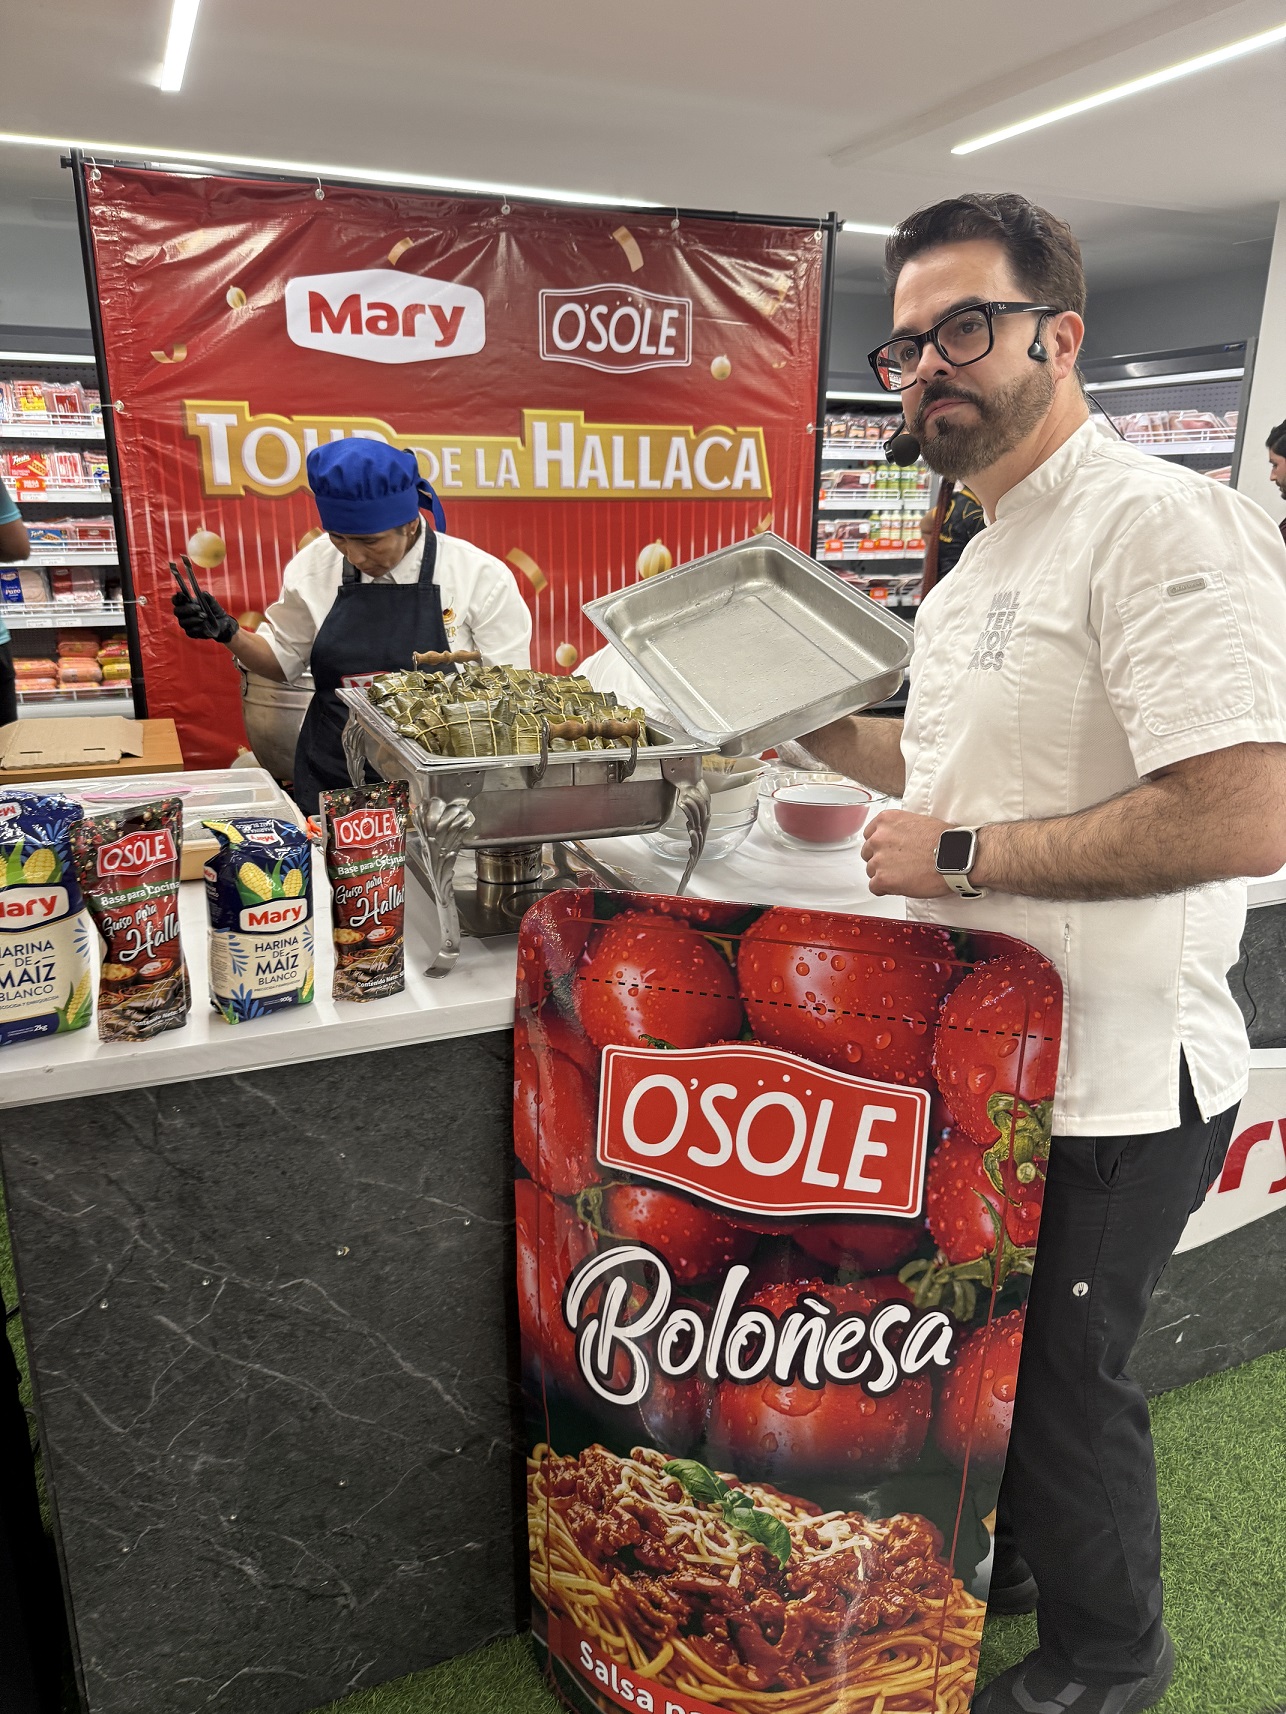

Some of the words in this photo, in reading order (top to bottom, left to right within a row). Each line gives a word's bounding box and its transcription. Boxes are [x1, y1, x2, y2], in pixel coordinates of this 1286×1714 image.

[308, 291, 466, 348] Mary
[196, 413, 388, 487] TO
[475, 448, 521, 489] LA
[532, 421, 763, 491] HALLACA
[985, 611, 1016, 631] TER
[974, 629, 1012, 651] KOV
[967, 650, 1005, 671] ACS
[337, 865, 359, 875] Base
[360, 862, 375, 873] para
[101, 894, 127, 906] Base
[127, 889, 147, 902] para
[335, 885, 363, 904] Guiso
[366, 875, 383, 894] para
[102, 916, 132, 938] Guiso
[135, 904, 158, 926] para
[248, 904, 303, 927] Mary
[0, 940, 55, 959] ARINA
[255, 936, 300, 953] HARINA
[272, 949, 285, 959] DE
[15, 956, 33, 968] DE
[255, 952, 300, 977] MAÍZ
[258, 970, 298, 986] BLANCO
[565, 1245, 954, 1406] Boloñesa
[579, 1640, 654, 1714] Salsa
